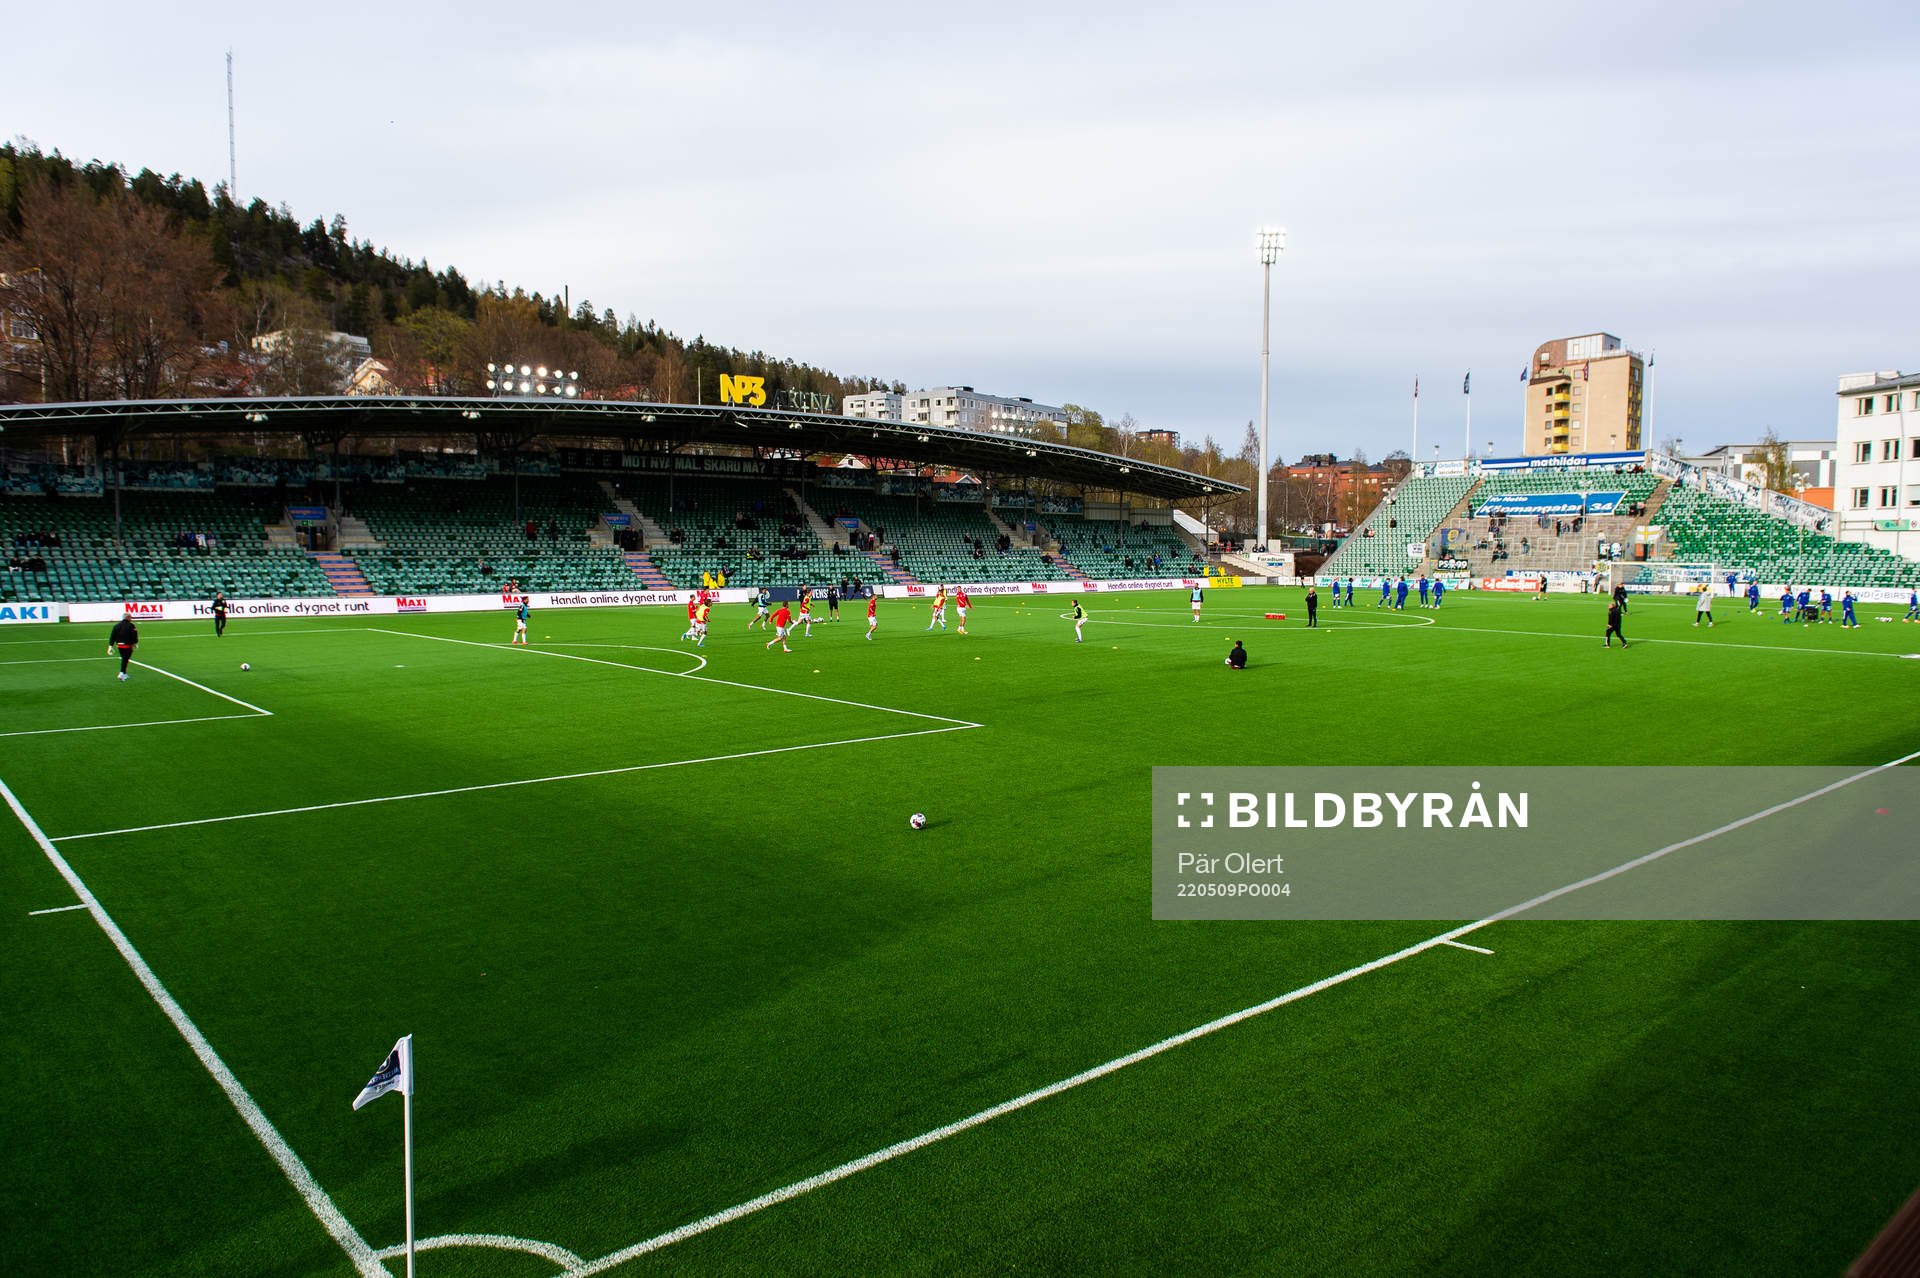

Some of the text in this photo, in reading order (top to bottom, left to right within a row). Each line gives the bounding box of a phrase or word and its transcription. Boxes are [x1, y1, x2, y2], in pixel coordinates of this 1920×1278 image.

[719, 373, 767, 406] NP3
[1530, 457, 1587, 467] mathildas
[1590, 503, 1613, 511] 34
[906, 585, 925, 593] MAXI
[396, 597, 427, 607] MAXI
[550, 592, 678, 605] Handla online dygnet runt
[0, 605, 49, 620] AKI
[125, 603, 163, 613] MAXI
[249, 602, 290, 614] online
[294, 601, 340, 615] dygnet
[344, 601, 370, 612] runt
